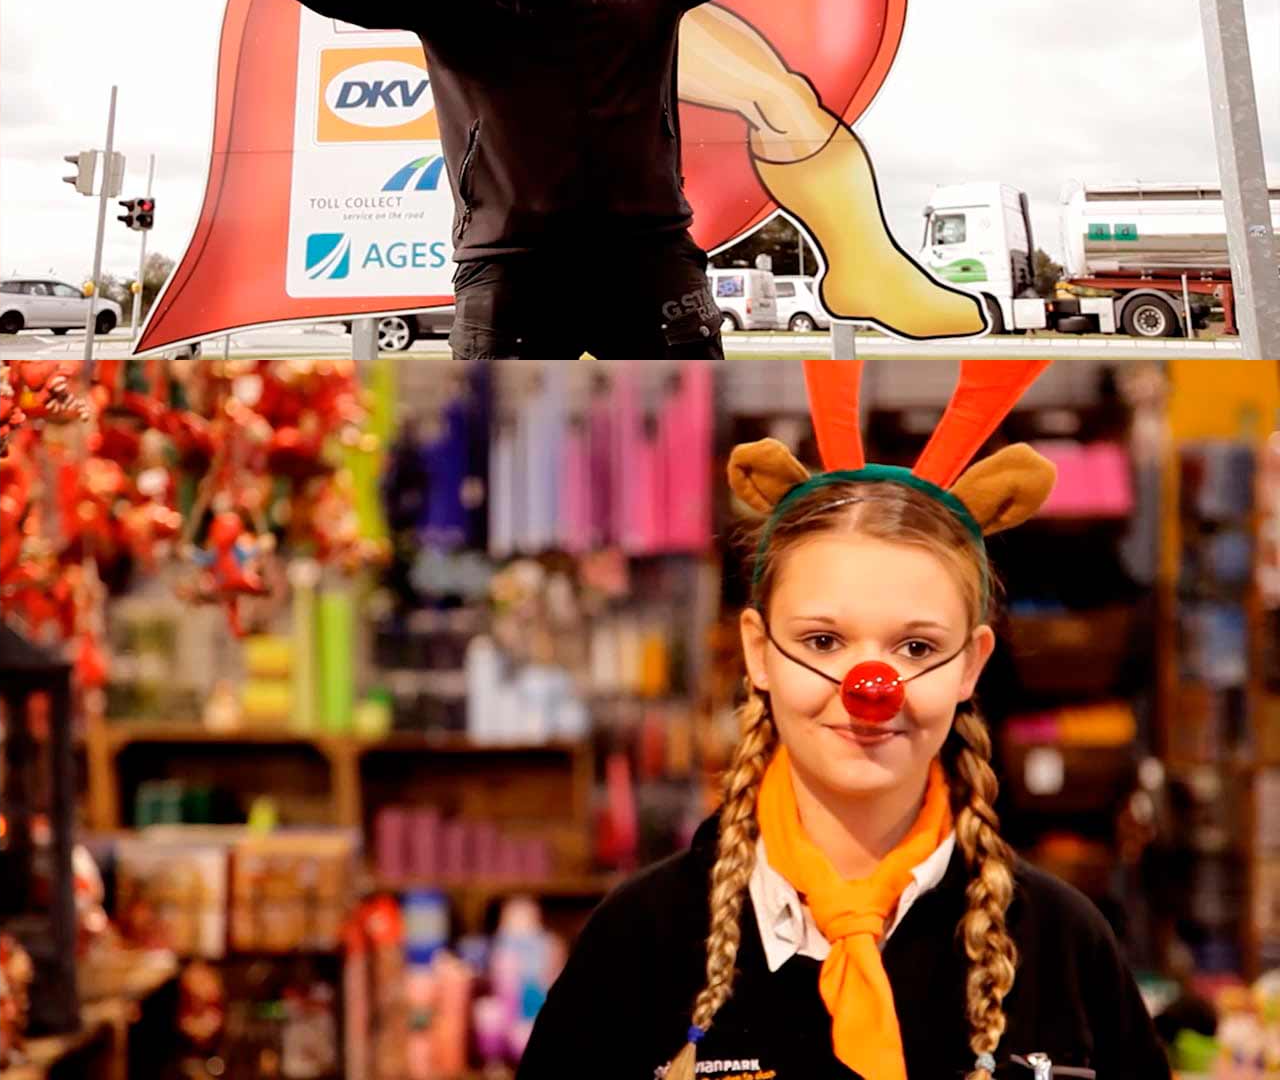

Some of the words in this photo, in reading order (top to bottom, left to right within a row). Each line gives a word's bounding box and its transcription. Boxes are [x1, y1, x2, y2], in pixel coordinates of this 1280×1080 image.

[334, 79, 430, 109] DKV
[309, 198, 340, 209] TOLL
[344, 196, 403, 209] COLLECT
[343, 211, 374, 220] service
[375, 212, 386, 220] on
[389, 211, 402, 219] the
[404, 210, 425, 219] road
[361, 242, 446, 269] AGES
